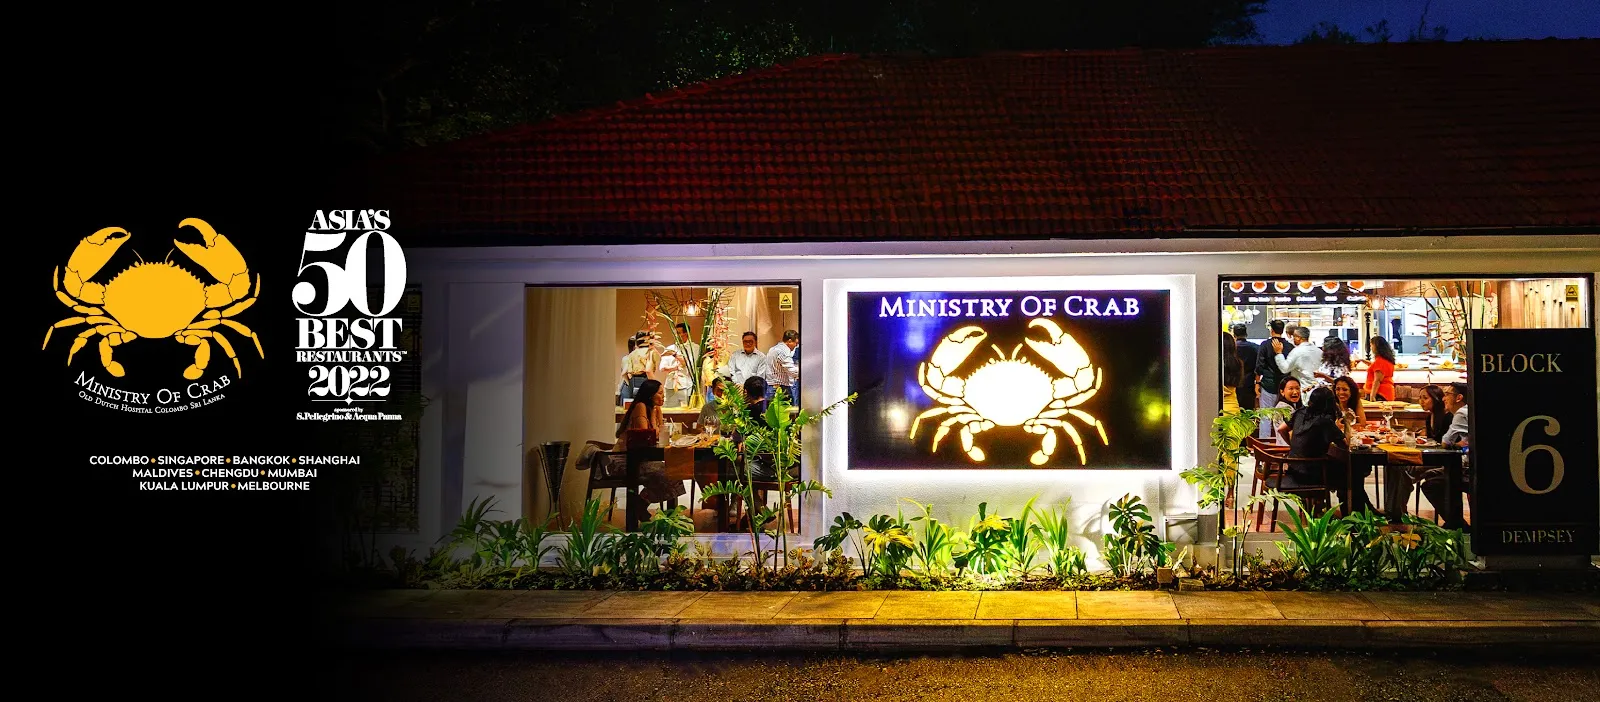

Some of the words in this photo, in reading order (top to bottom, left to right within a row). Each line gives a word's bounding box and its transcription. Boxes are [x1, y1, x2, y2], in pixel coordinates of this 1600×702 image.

[879, 296, 1013, 318] MINISTRY
[1020, 295, 1057, 318] OF
[1063, 295, 1140, 317] CRAB
[1481, 353, 1563, 373] BLOCK
[1509, 414, 1565, 495] 6
[1502, 529, 1576, 544] DEMPSEY
